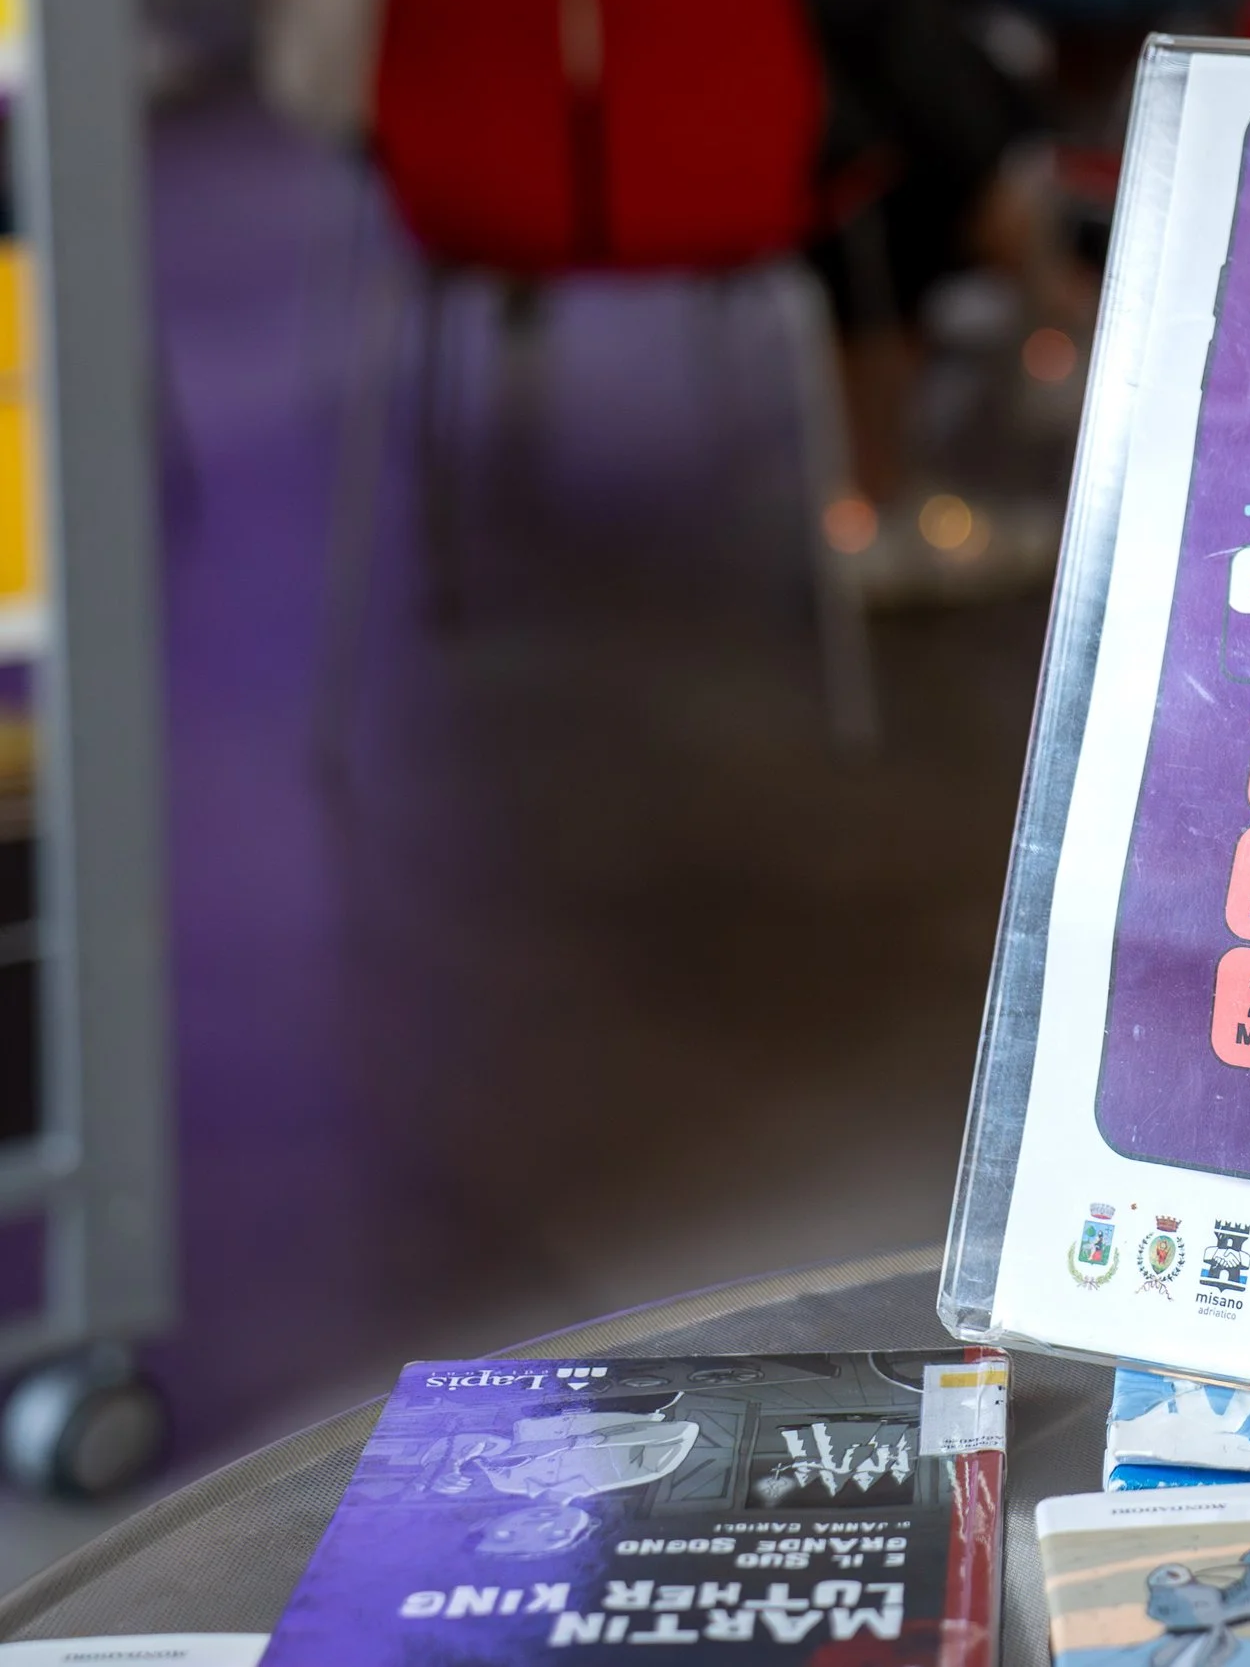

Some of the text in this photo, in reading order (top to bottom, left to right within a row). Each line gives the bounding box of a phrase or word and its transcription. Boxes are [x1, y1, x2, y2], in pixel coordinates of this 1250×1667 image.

[1195, 1291, 1243, 1310] misano
[1198, 1306, 1236, 1321] adriatico
[426, 1370, 548, 1390] Lapis
[814, 1521, 888, 1533] JANNA
[615, 1535, 907, 1555] GRANDE SOGNO
[734, 1551, 906, 1570] E IL SUO
[396, 1579, 905, 1619] LUTHER KING
[546, 1603, 904, 1649] MARTIN
